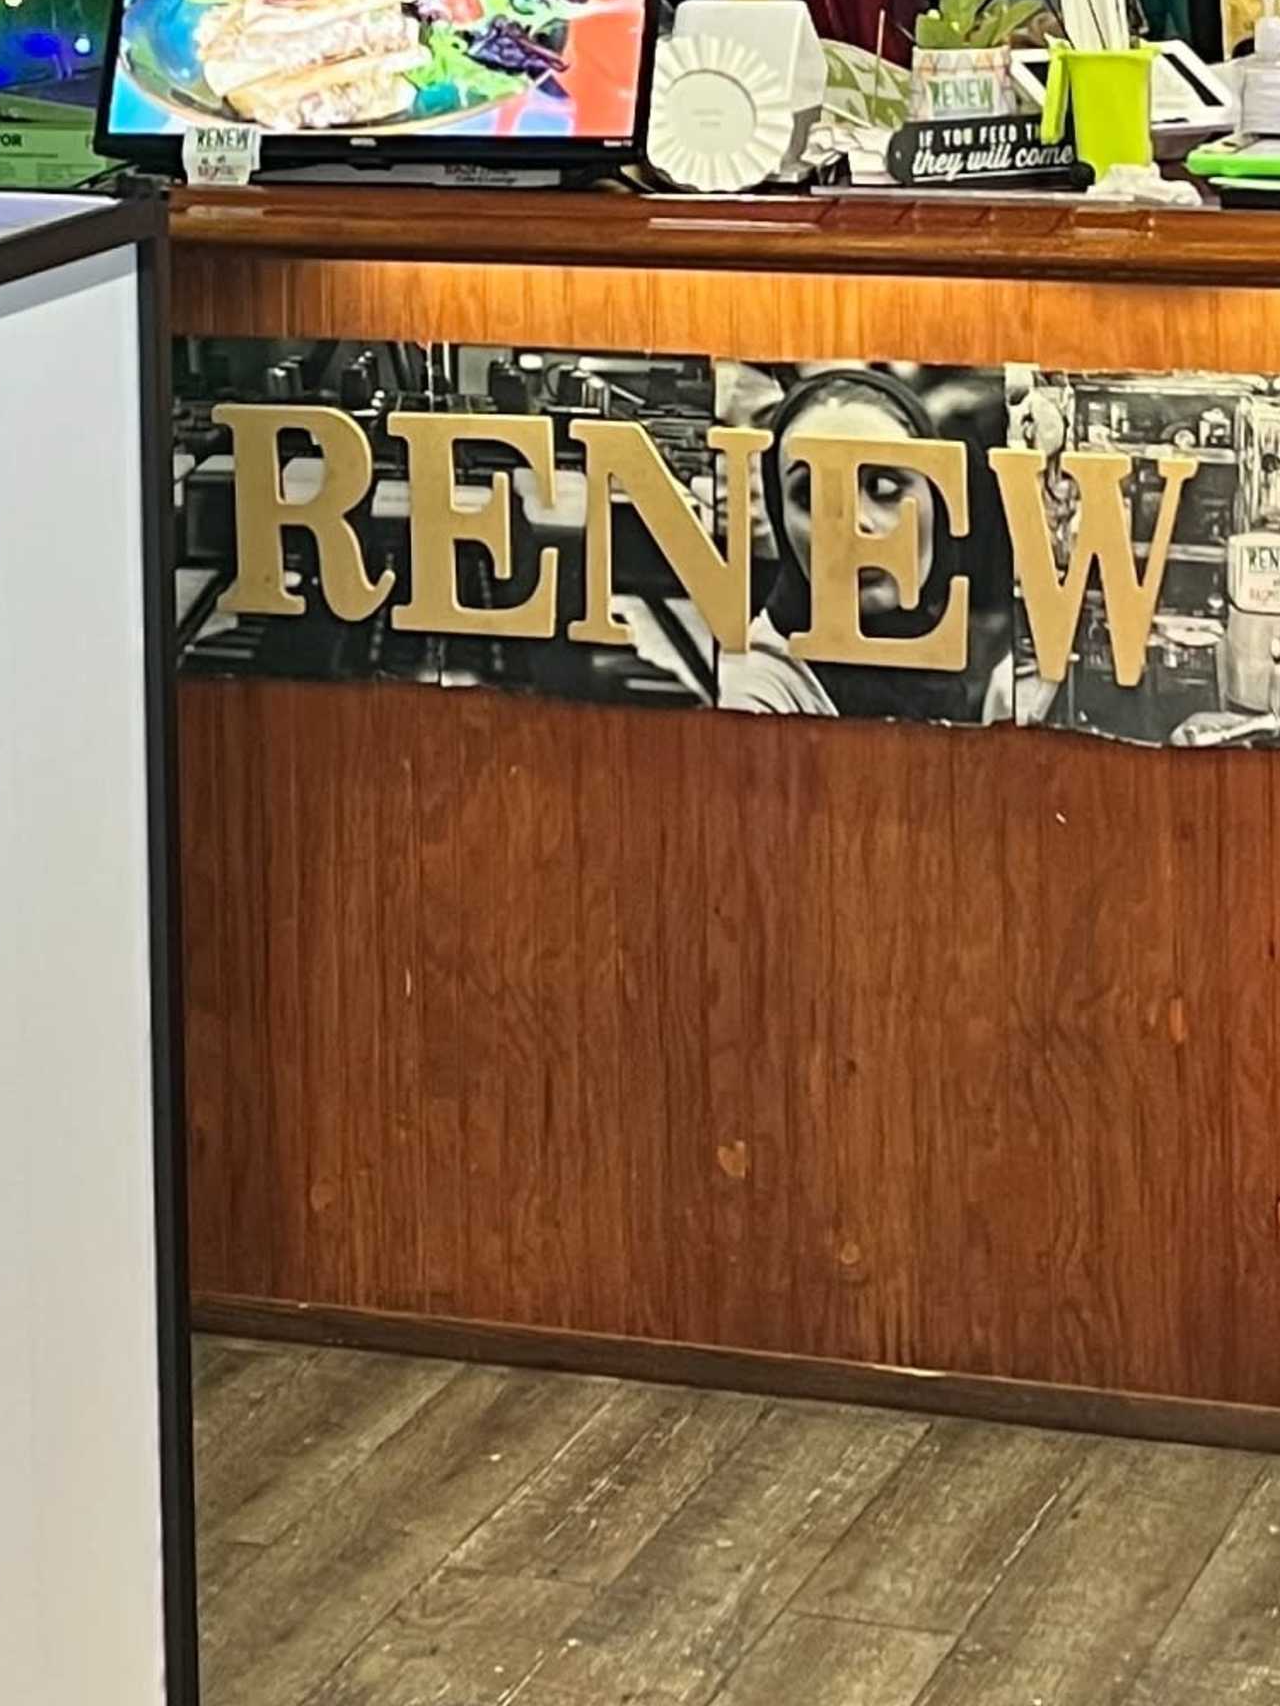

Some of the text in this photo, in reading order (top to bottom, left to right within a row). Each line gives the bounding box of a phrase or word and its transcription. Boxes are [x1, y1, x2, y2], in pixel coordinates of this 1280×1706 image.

[927, 79, 993, 108] RENEW
[919, 130, 933, 148] IF
[942, 128, 973, 148] YOU
[979, 124, 1018, 144] FEED
[912, 143, 1074, 181] they will come
[211, 402, 1200, 688] RENEW
